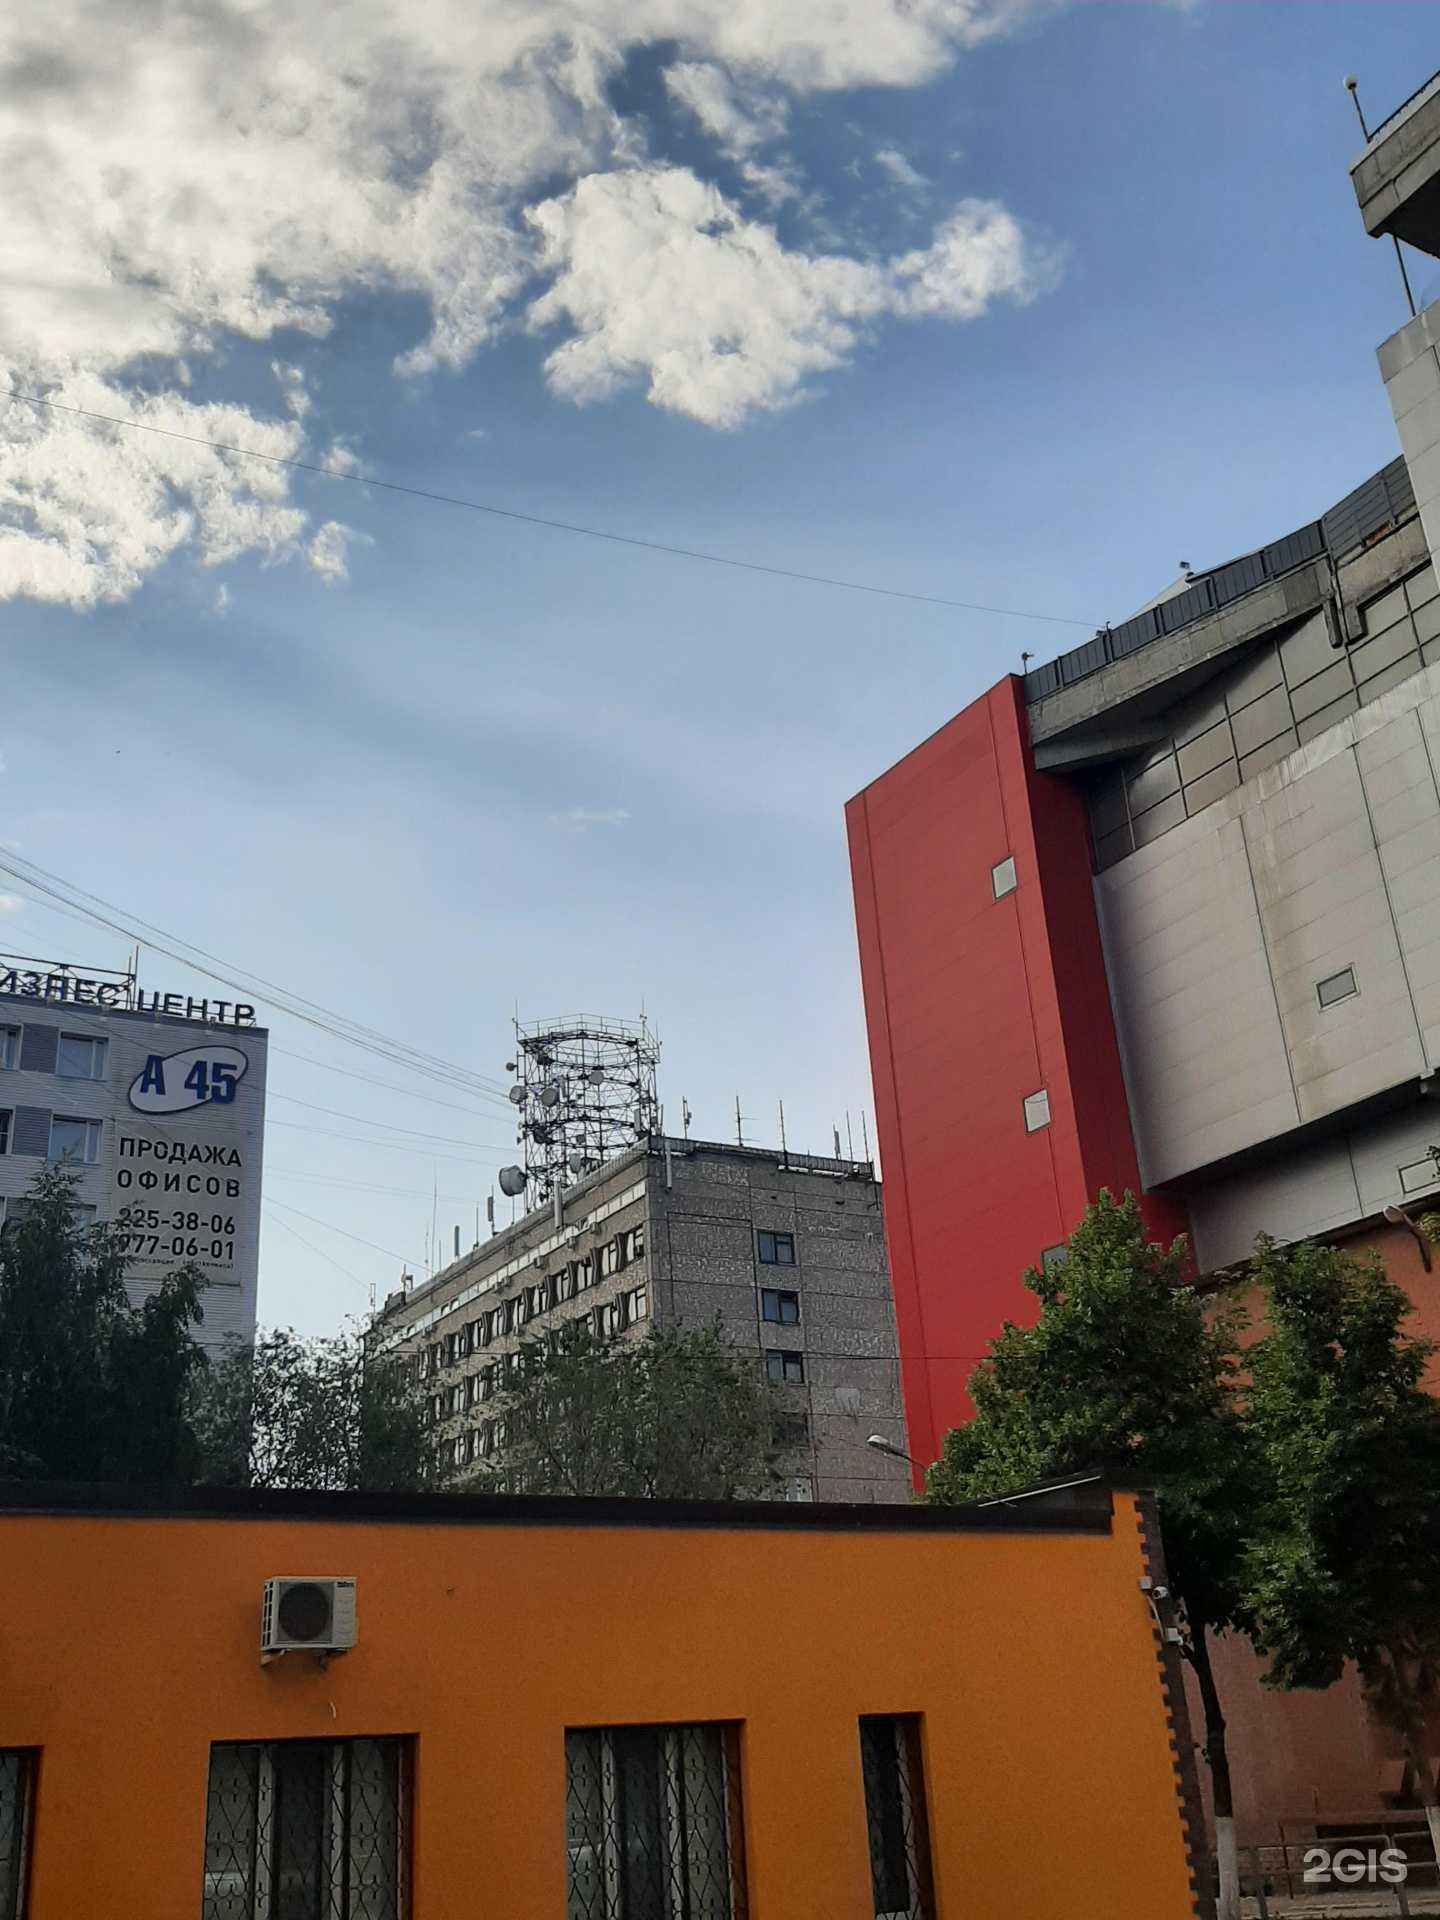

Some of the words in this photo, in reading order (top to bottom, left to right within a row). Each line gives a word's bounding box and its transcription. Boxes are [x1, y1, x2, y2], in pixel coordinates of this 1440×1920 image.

[138, 989, 256, 1024] ЦЕНТР
[184, 1060, 237, 1104] 45
[119, 1137, 242, 1167] ПРОДАЖА
[117, 1169, 240, 1198] ОФИСОВ
[119, 1207, 236, 1235] 225-38-06
